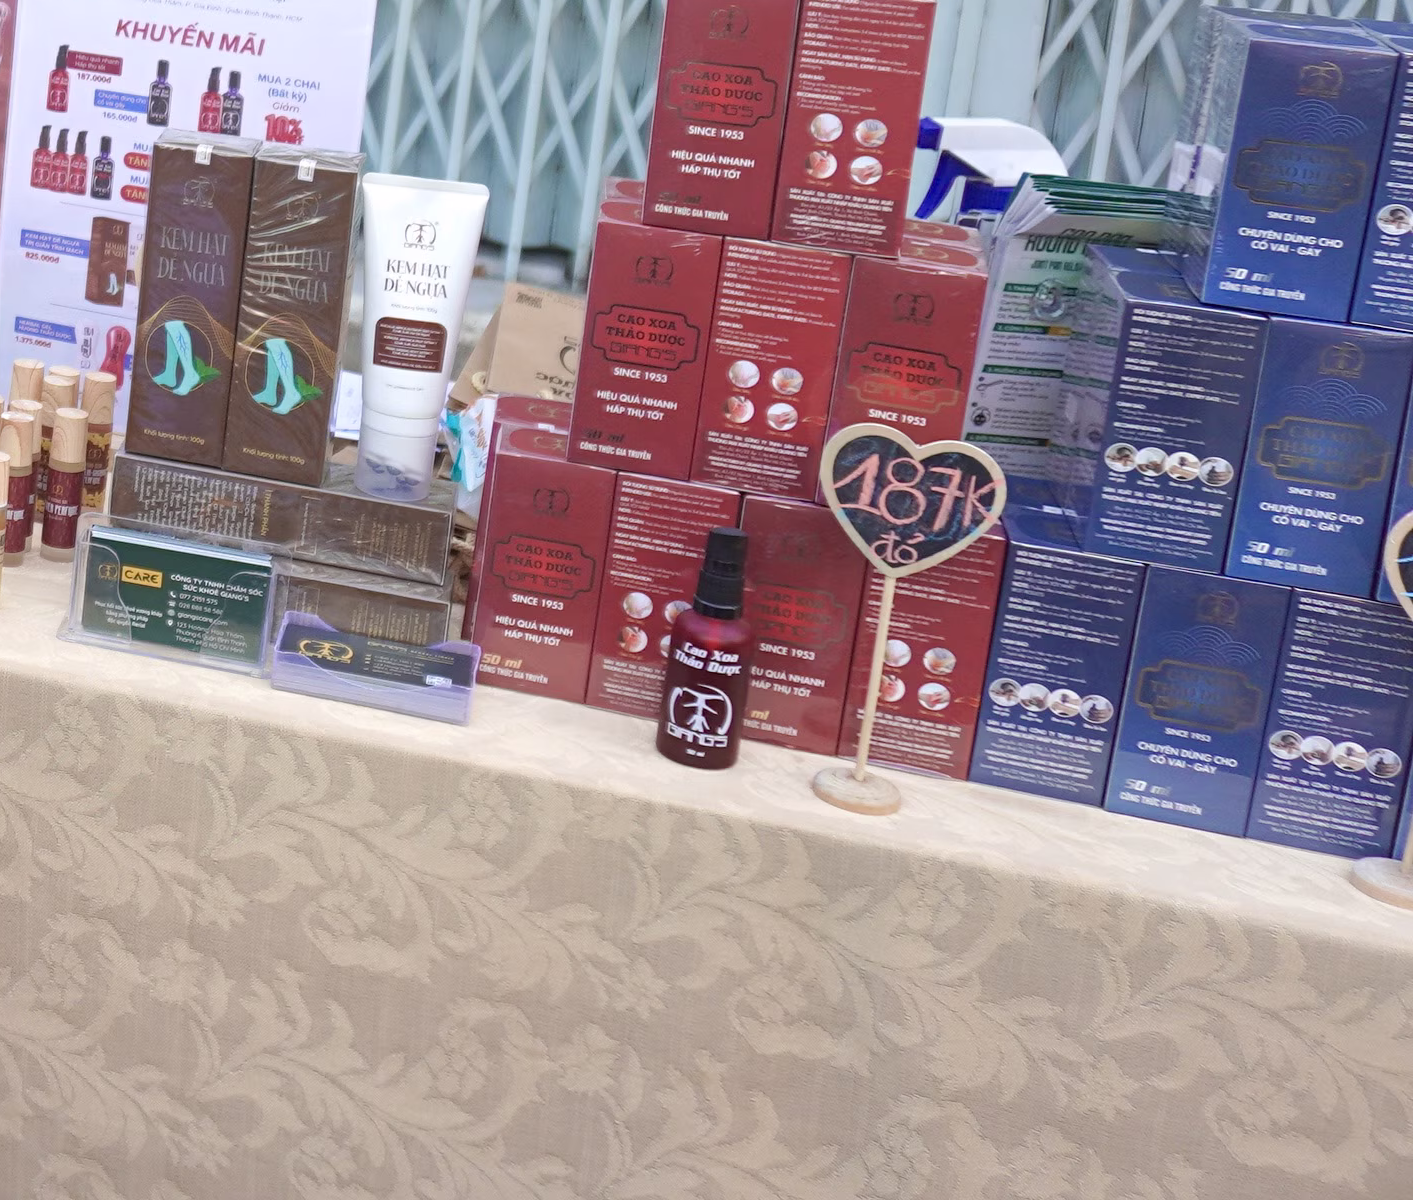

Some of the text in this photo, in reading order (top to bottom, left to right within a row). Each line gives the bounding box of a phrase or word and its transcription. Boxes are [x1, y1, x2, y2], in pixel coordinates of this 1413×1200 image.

[115, 18, 266, 56] KHUYẾN MÃI
[258, 73, 321, 90] MUA 2 CHAI
[692, 71, 753, 85] CAO XOA
[689, 126, 744, 141] SINCE 1953
[671, 150, 755, 168] HIỆU QUẢ NHANH
[681, 163, 742, 179] HẤP THỤ TỐT
[655, 203, 673, 214] CÔNG
[691, 208, 704, 218] GIA
[160, 226, 229, 261] KEM HẠT
[1238, 226, 1343, 249] CHUYÊN DÙNG CHO
[1269, 242, 1290, 253] VAI
[180, 260, 225, 289] NGỰA
[386, 259, 450, 281] KEM HẠT
[406, 281, 448, 299] NGỰA
[617, 314, 677, 331] CAO XOA
[606, 324, 645, 340] THẢO
[874, 352, 937, 372] CAO XOA
[613, 367, 668, 383] SINCE 1953
[596, 390, 678, 411] HIỆU QUẢ NHANH
[606, 404, 665, 422] HẤP THỤ TỐT
[868, 408, 927, 427] SINCE 1953
[144, 428, 157, 436] Khối
[190, 436, 205, 445] 100g
[243, 447, 256, 455] Khối
[290, 455, 305, 465] 100g
[833, 454, 1004, 532] 187K
[1259, 501, 1364, 525] CHUYÊN DÙNG CHO
[1291, 516, 1310, 529] VAI
[124, 569, 159, 584] CARE
[171, 574, 191, 583] CÔNG
[204, 580, 224, 589] TNHH
[183, 583, 198, 592] SỨC
[220, 591, 249, 602] GIANG'S
[511, 593, 564, 611] SINCE 1953
[495, 615, 573, 637] HIỆU QUẢ NHANH
[481, 653, 523, 669] 50 ml
[683, 641, 740, 663] Cao Xoa
[675, 648, 742, 676] Thảo Dược
[479, 664, 496, 675] CÔNG
[514, 670, 525, 680] GIA
[765, 669, 825, 688] QUẢ NHANH
[752, 679, 811, 698] HẤP THỤ TỐT
[751, 709, 770, 720] ml
[1137, 740, 1238, 768] CHUYÊN DÙNG CHO
[1167, 758, 1187, 770] VAI
